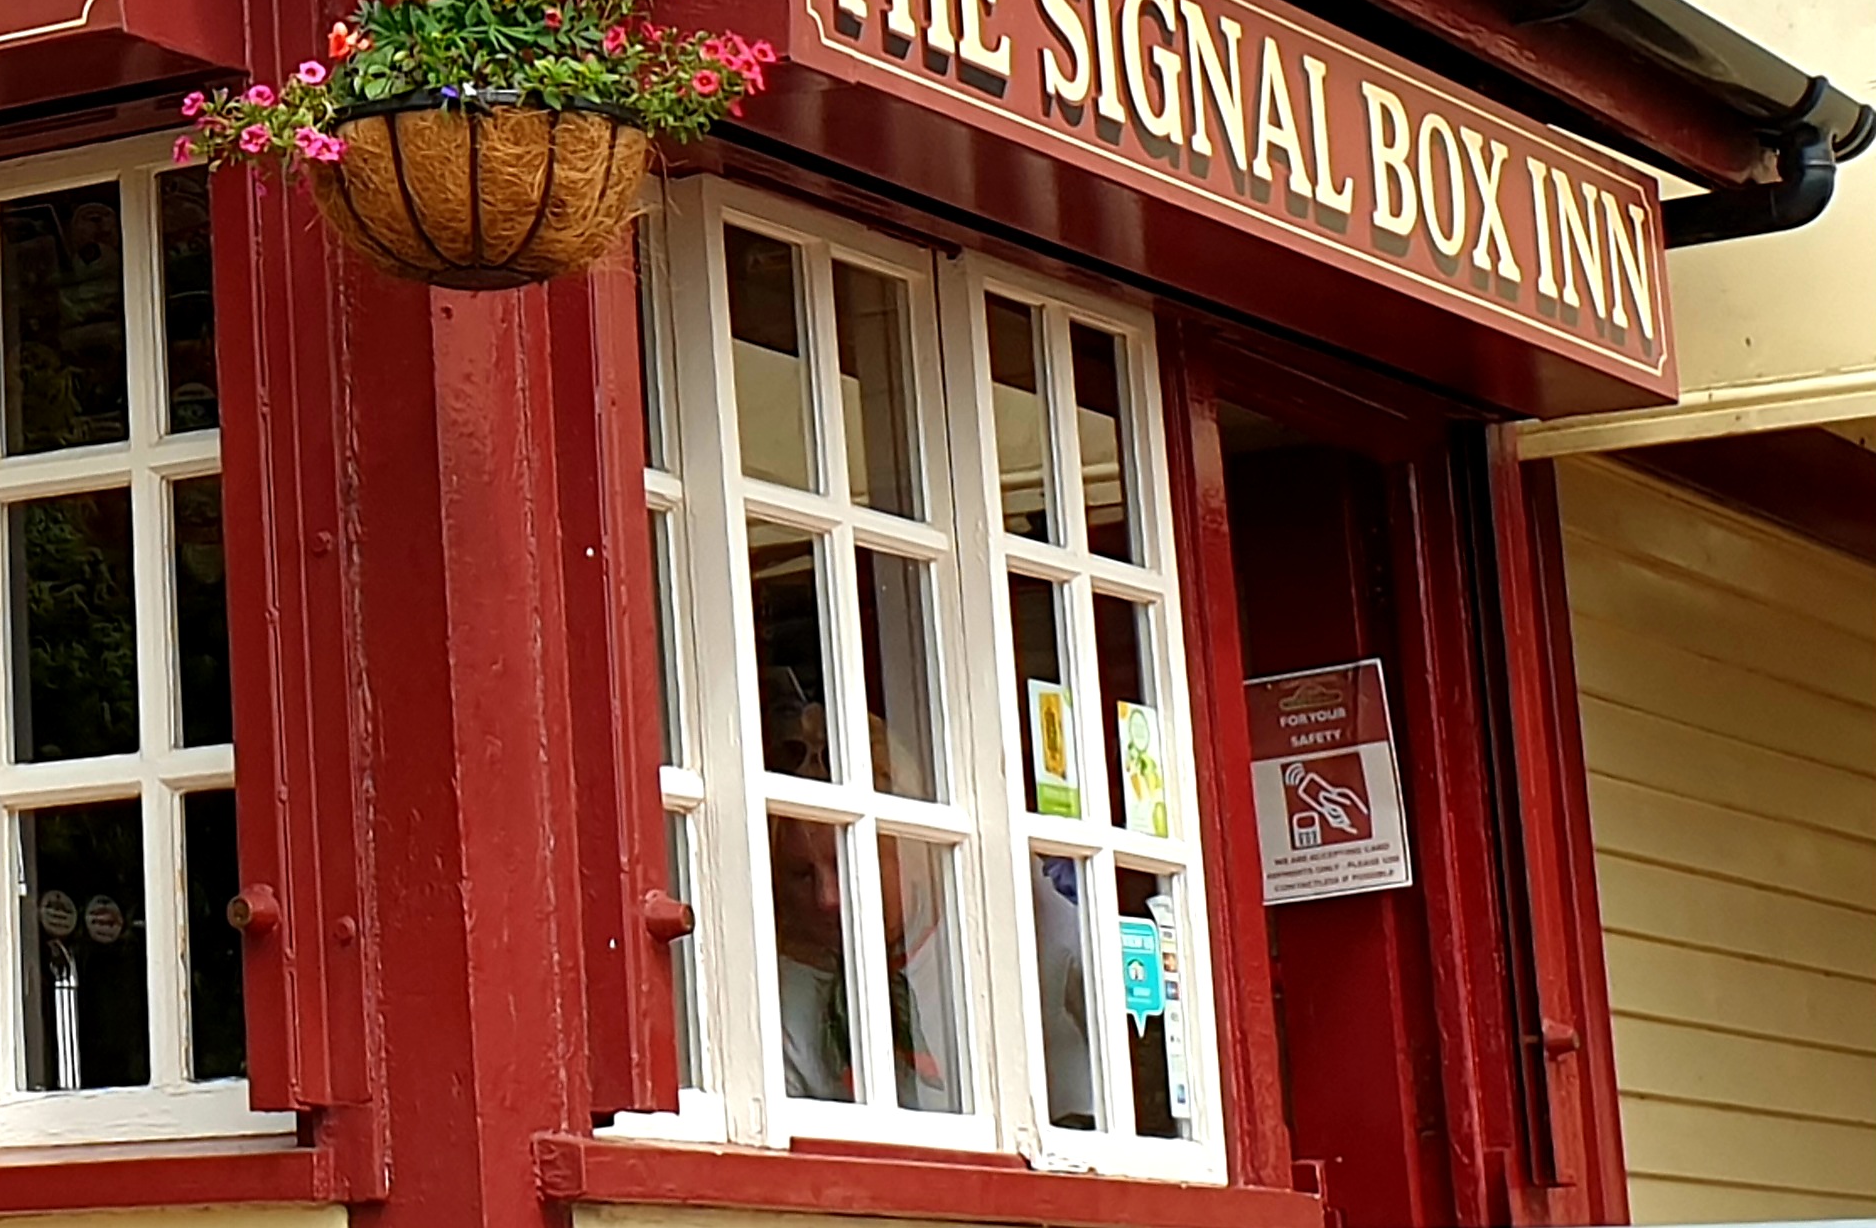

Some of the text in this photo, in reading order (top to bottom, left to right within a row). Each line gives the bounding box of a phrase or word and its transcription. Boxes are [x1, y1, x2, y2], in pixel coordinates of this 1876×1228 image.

[1361, 80, 1522, 283] BOX
[1526, 155, 1654, 340] INN
[1279, 707, 1347, 728] FOR YOUR
[1290, 729, 1342, 748] SAFETY
